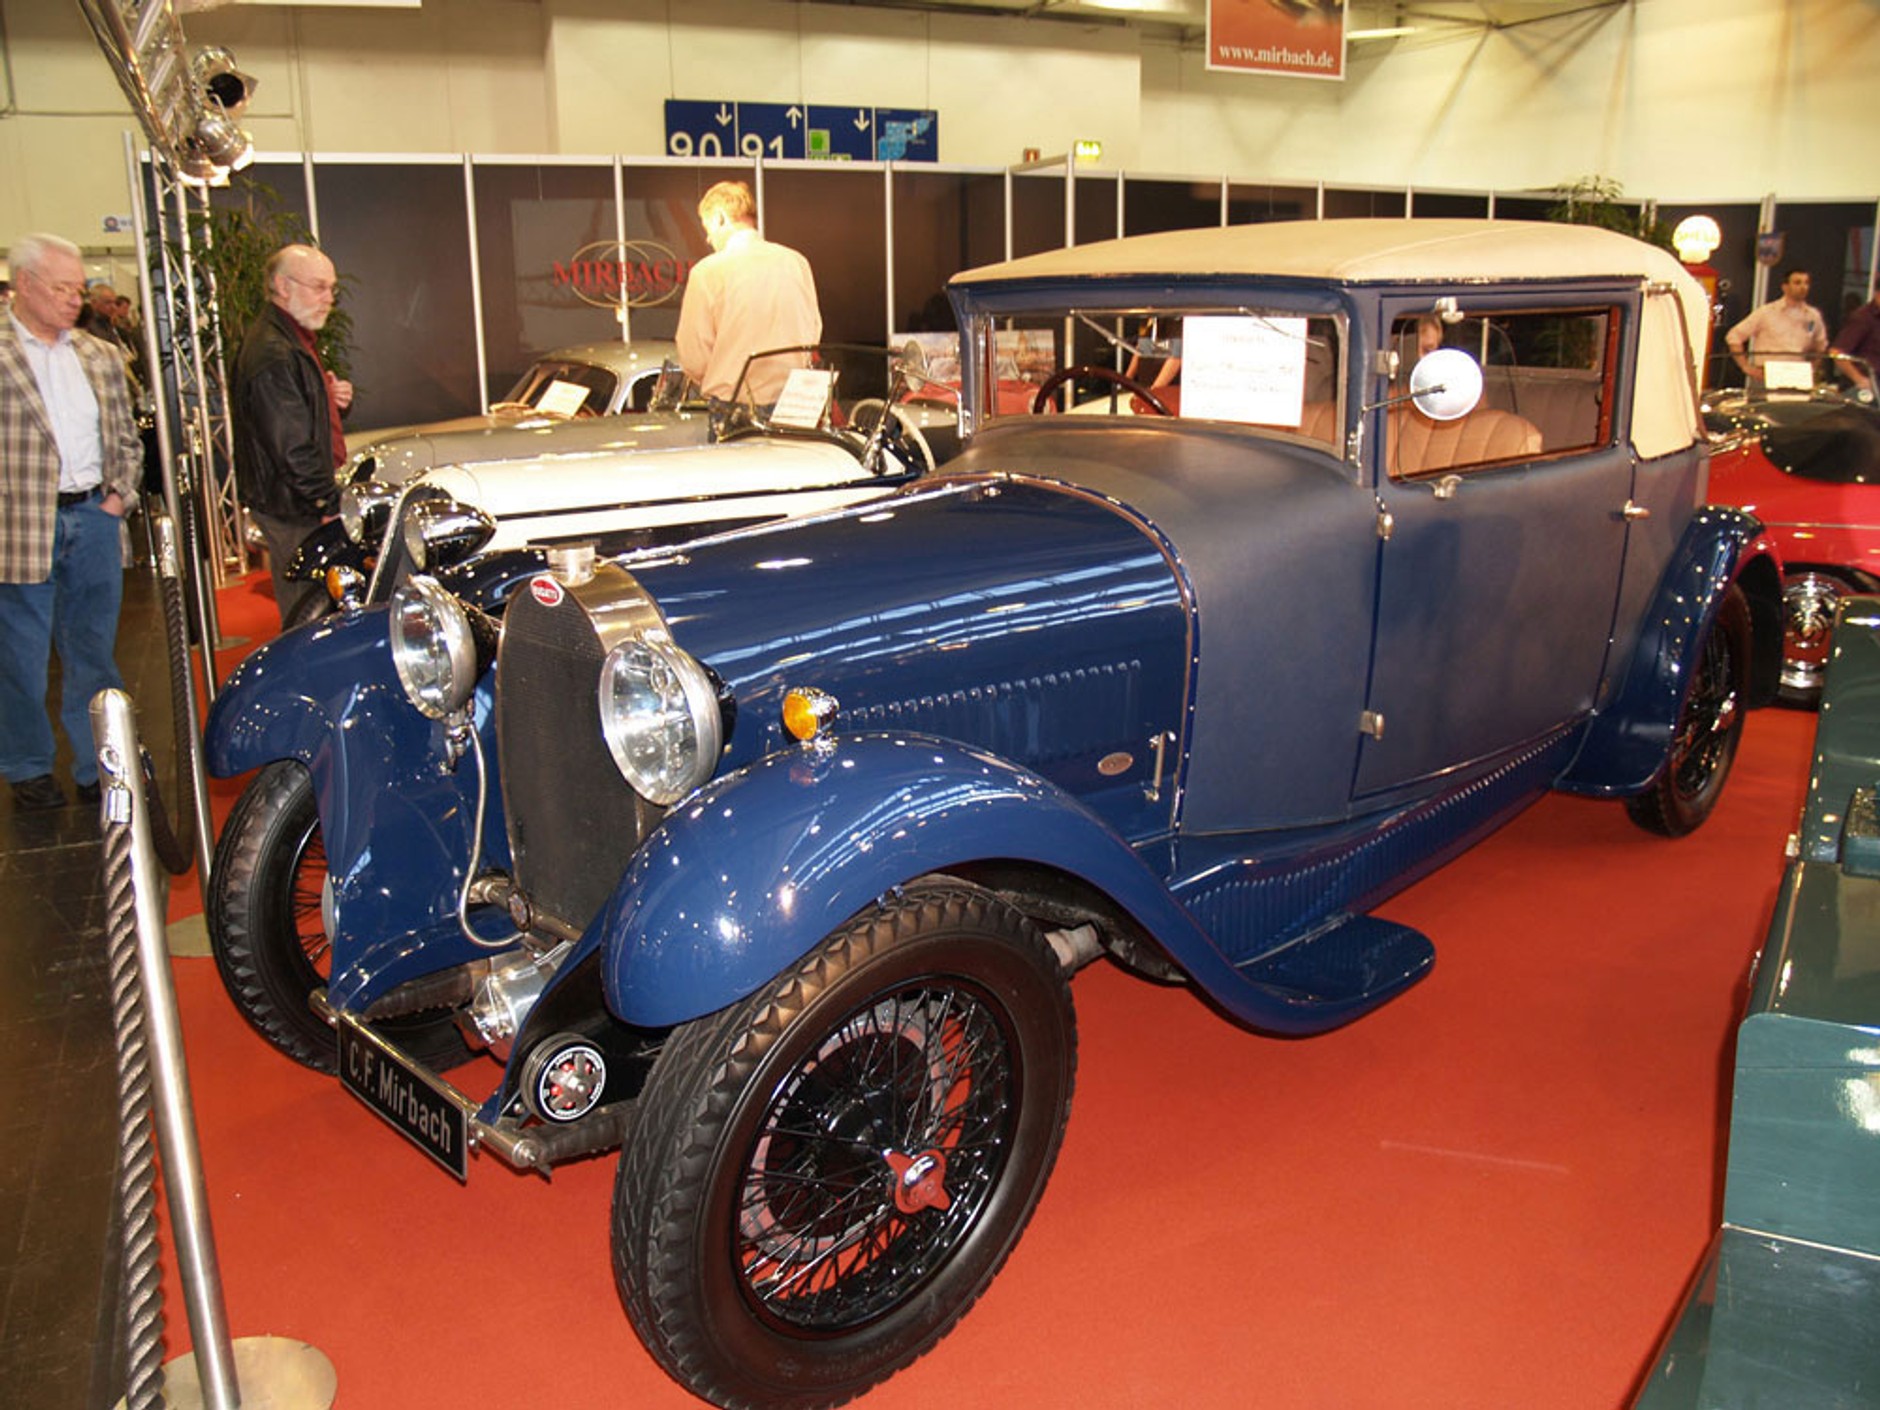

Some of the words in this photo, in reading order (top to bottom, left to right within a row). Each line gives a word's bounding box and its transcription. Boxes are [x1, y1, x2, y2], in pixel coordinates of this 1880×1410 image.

[1218, 45, 1335, 69] www.mirbach.de
[669, 131, 723, 157] 90
[741, 133, 784, 159] 91
[350, 1040, 376, 1093] C.F.
[379, 1060, 451, 1154] Mirbach
